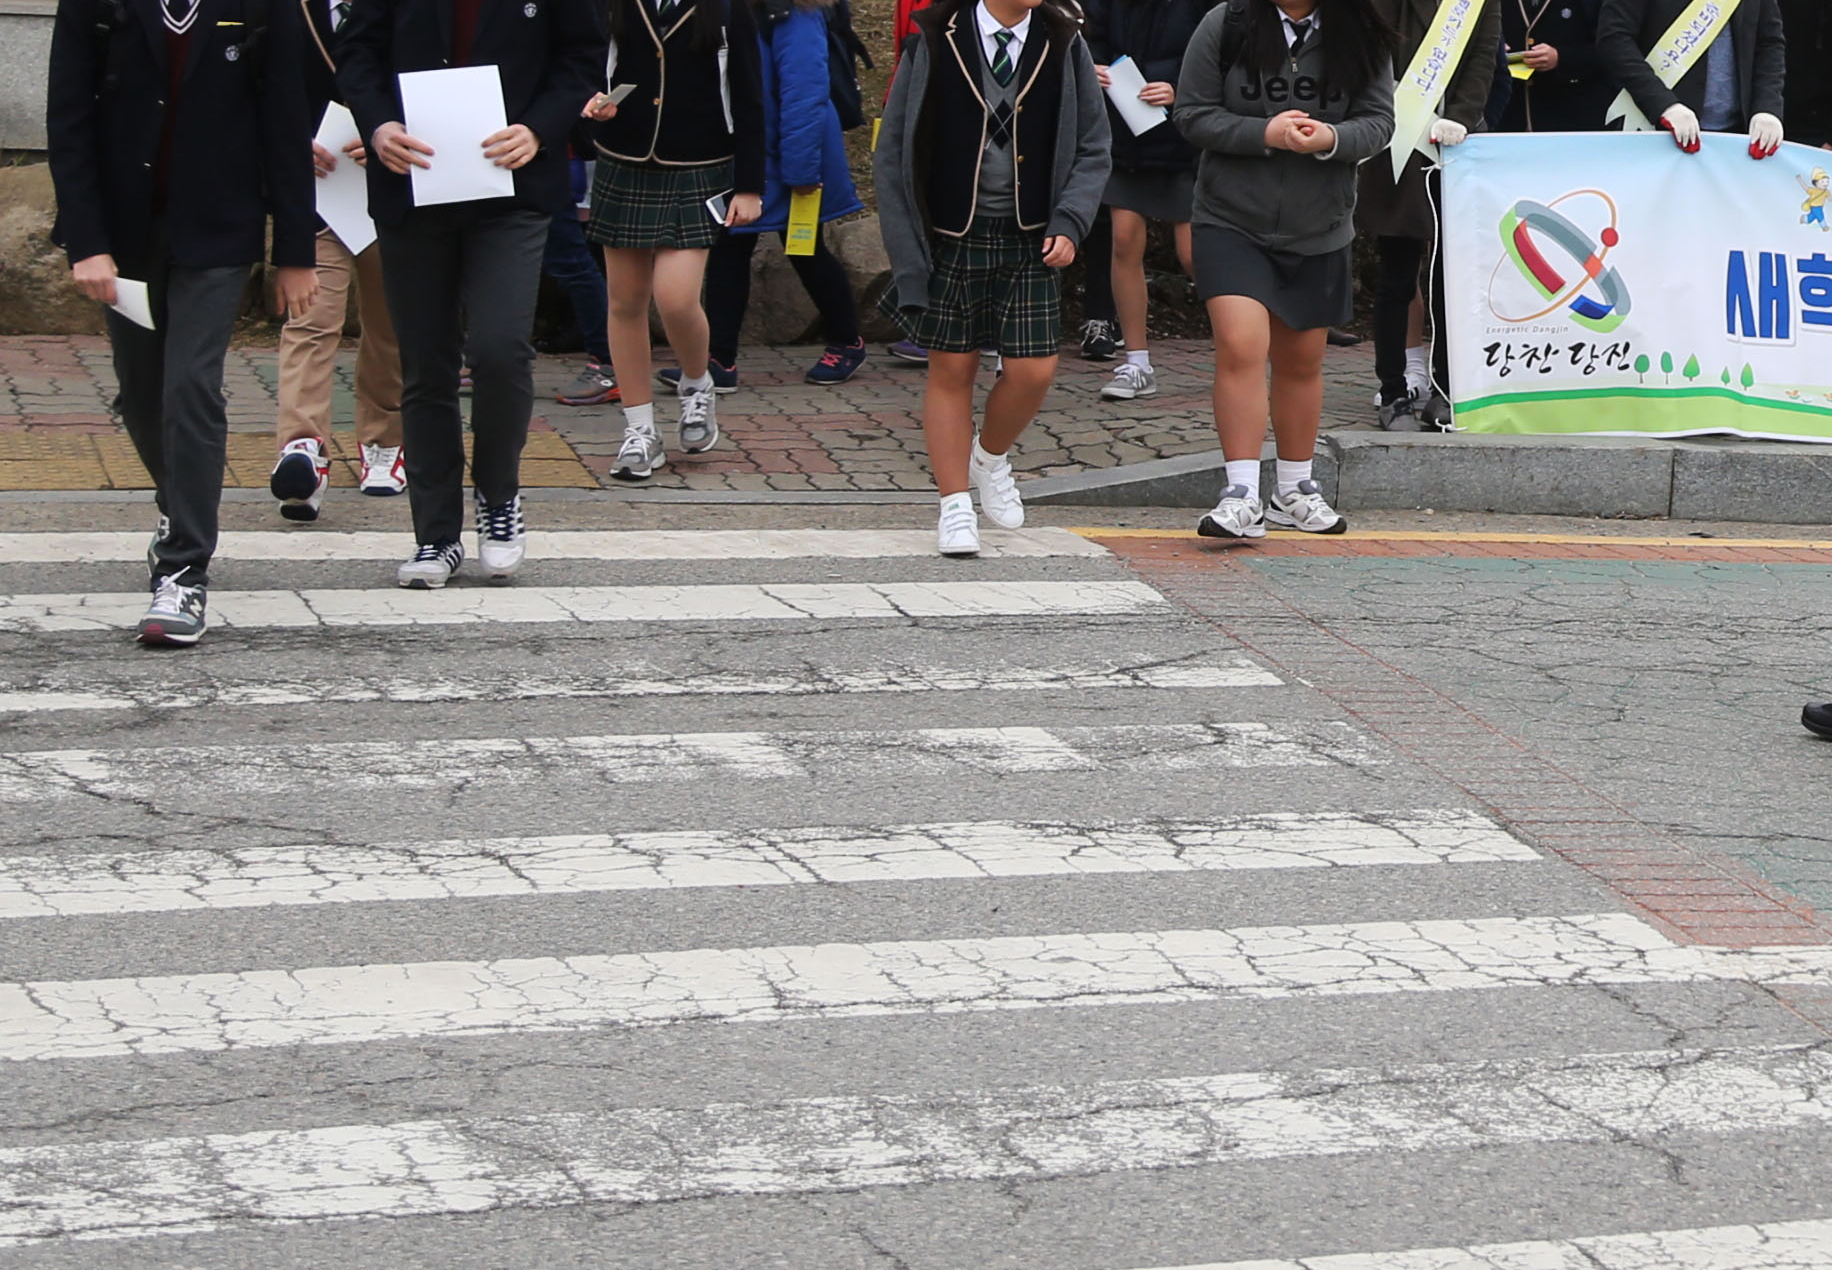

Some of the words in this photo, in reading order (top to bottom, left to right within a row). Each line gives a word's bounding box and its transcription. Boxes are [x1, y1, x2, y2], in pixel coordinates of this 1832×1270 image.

[1486, 325, 1529, 335] Energetic
[1532, 325, 1569, 335] Dangjin
[1483, 341, 1560, 378] 당찬
[1568, 341, 1631, 377] 당진
